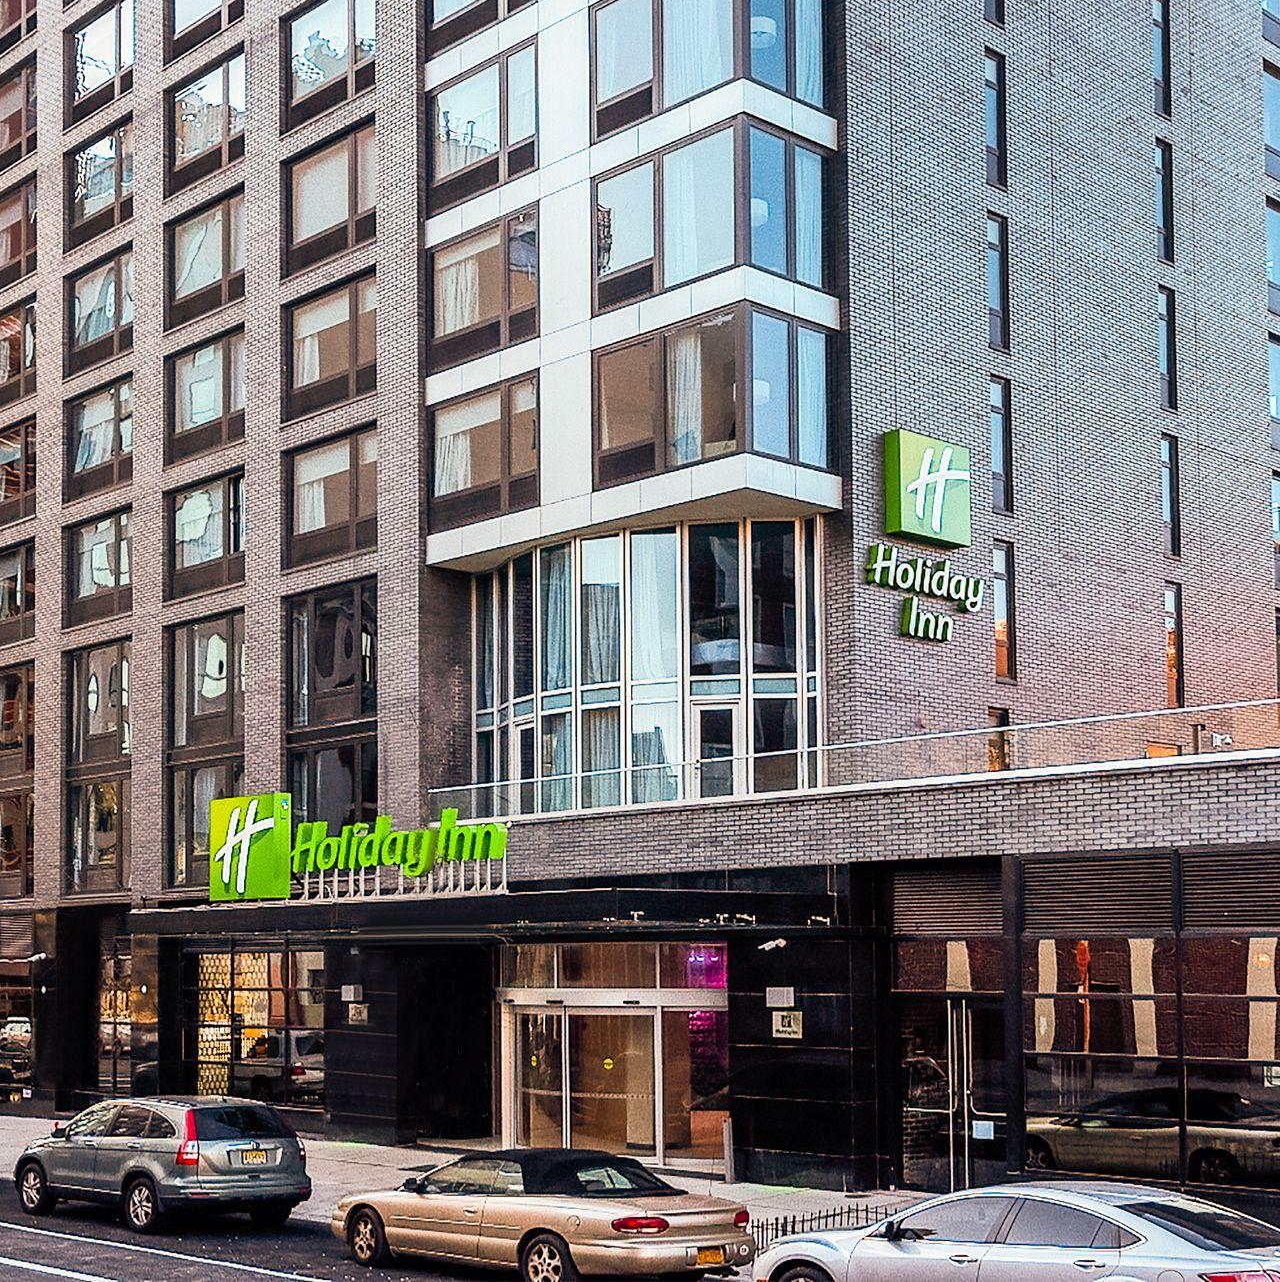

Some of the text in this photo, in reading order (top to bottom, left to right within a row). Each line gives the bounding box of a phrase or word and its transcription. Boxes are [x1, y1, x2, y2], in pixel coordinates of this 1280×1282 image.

[870, 542, 986, 613] Holiday
[907, 595, 955, 643] Inn
[291, 807, 508, 878] Holiday Inn
